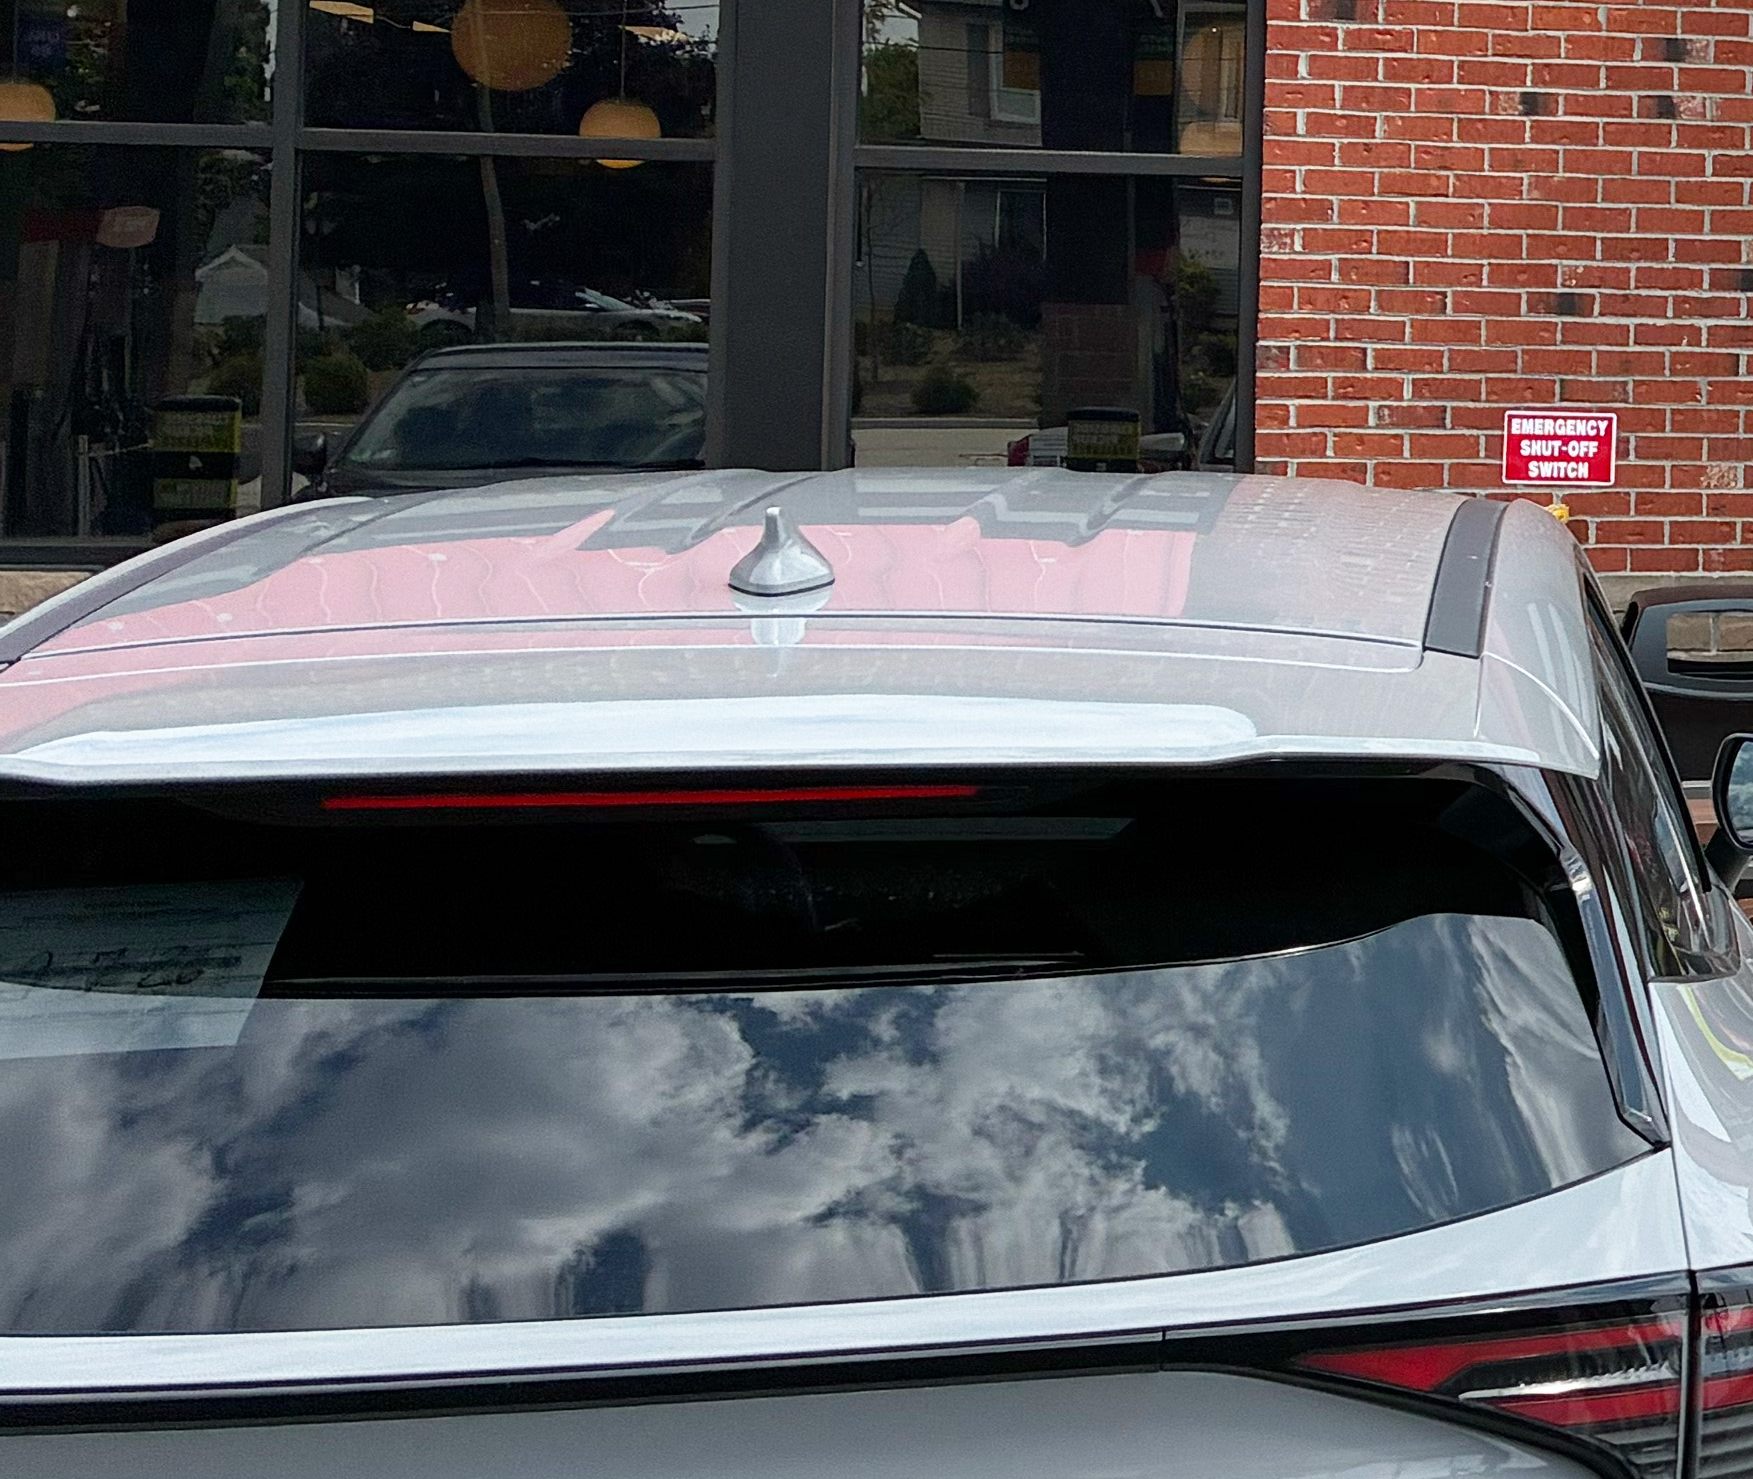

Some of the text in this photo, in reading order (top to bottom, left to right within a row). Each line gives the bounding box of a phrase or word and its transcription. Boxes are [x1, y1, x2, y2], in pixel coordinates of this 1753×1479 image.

[1511, 418, 1608, 436] EMERGENCY
[1520, 439, 1599, 457] SHUT-OFF
[1528, 460, 1589, 478] SWITCH
